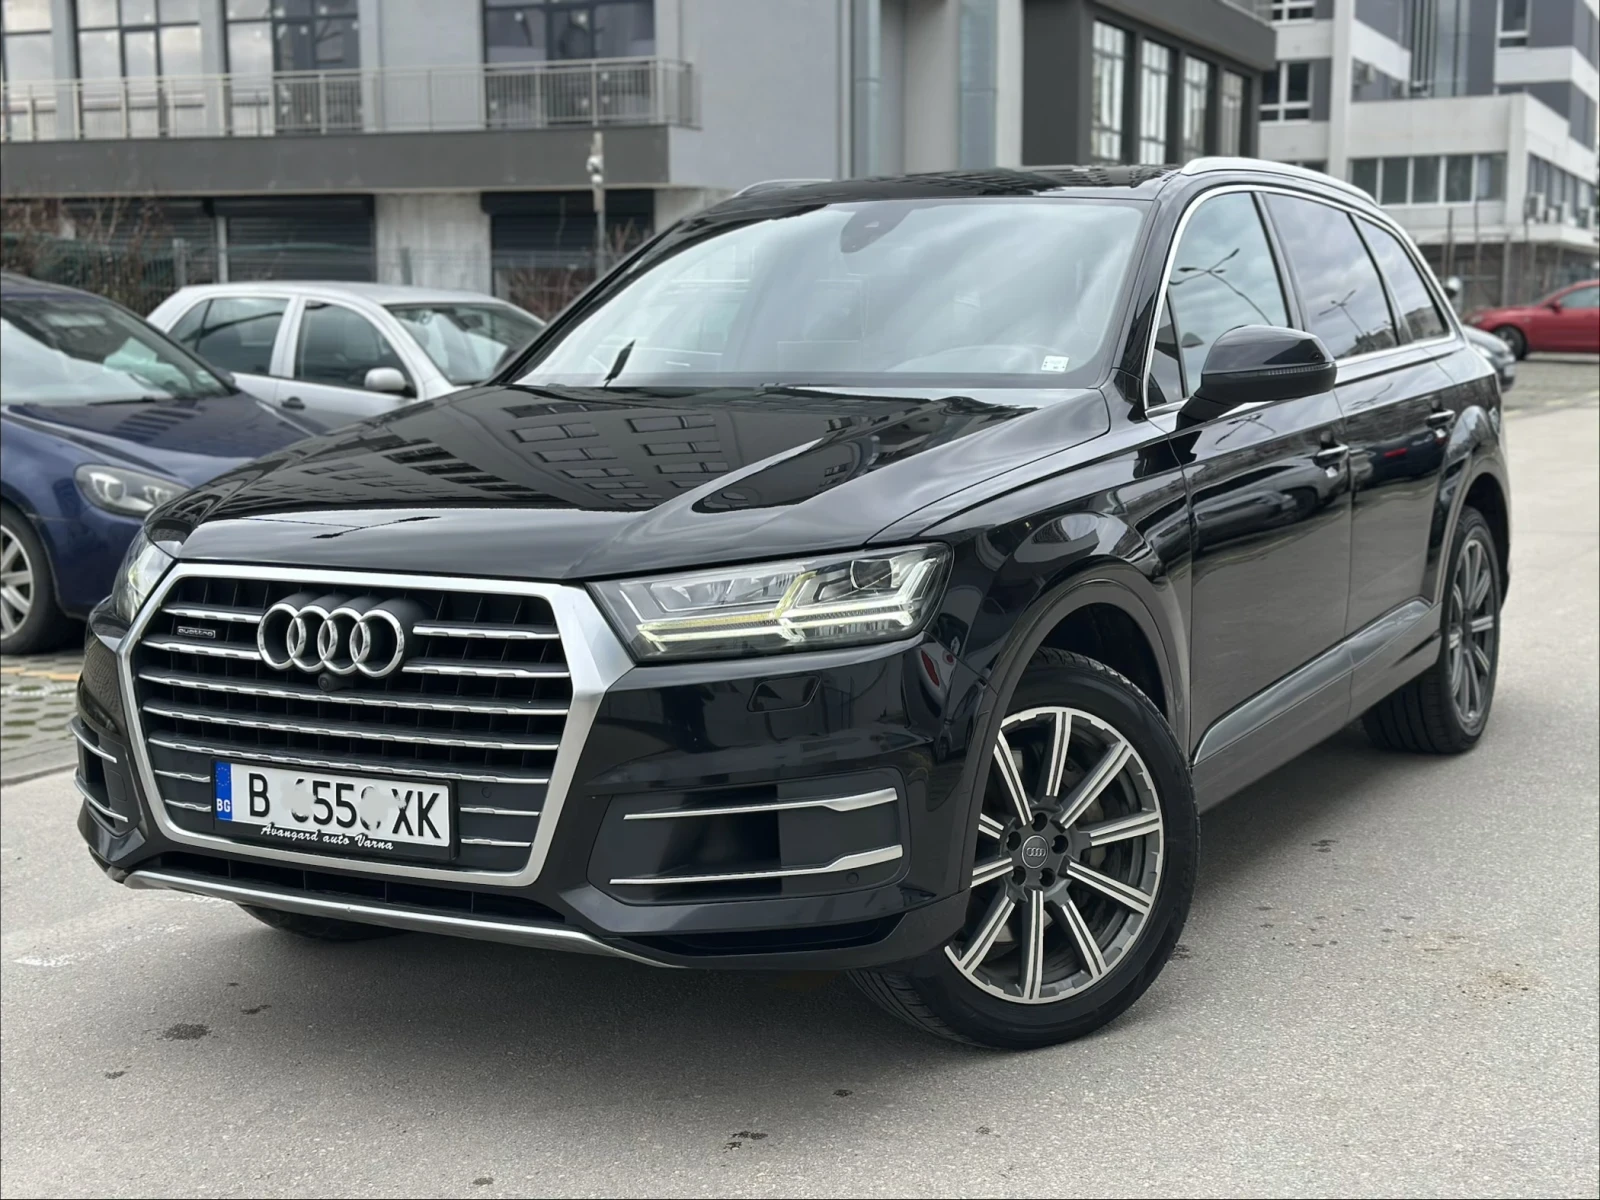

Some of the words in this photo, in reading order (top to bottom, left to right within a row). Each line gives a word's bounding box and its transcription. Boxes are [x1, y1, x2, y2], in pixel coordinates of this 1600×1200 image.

[216, 798, 231, 813] BG
[249, 772, 270, 818] B
[291, 778, 382, 832] 55
[260, 822, 319, 841] Avangard
[322, 833, 350, 845] auto
[354, 833, 394, 850] Varna
